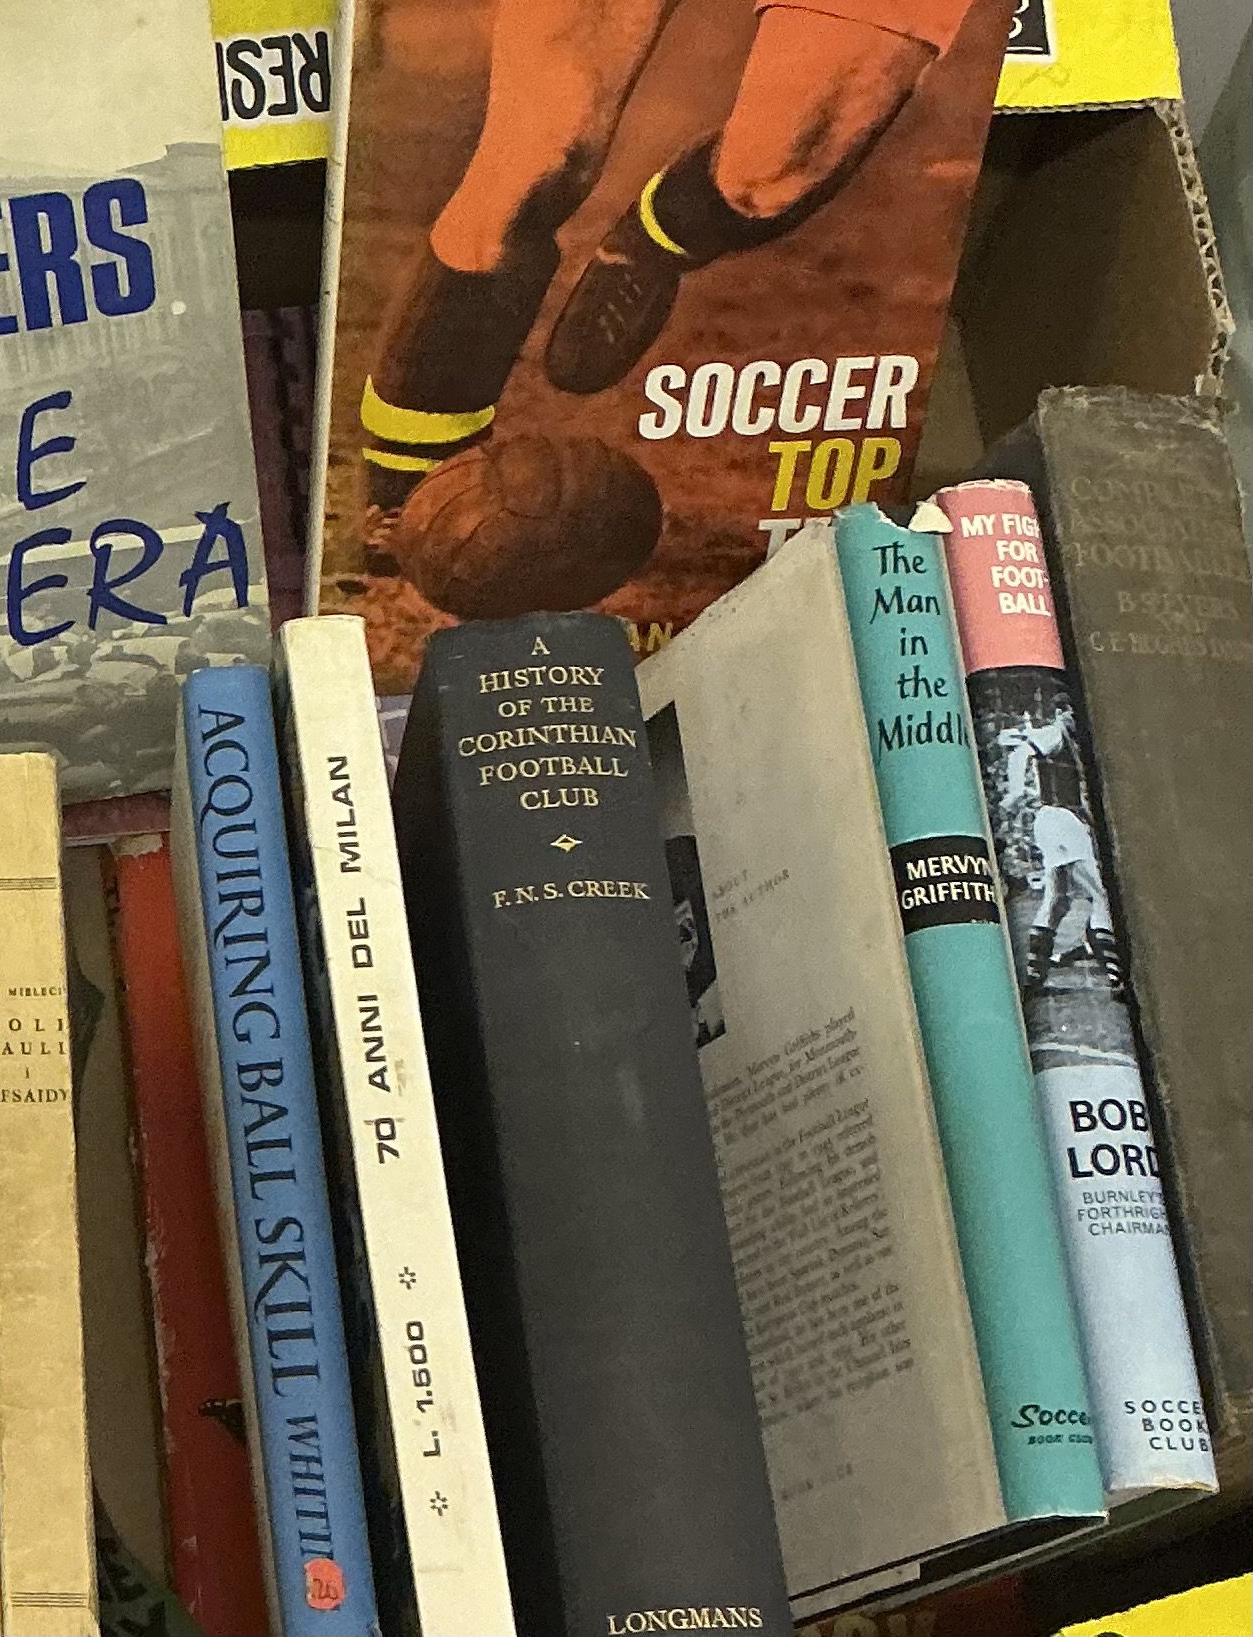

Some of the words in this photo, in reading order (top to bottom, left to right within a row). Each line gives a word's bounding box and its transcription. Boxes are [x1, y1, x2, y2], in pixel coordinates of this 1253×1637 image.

[215, 31, 332, 121] RES
[639, 354, 920, 440] SOCCER
[768, 437, 903, 511] TOP
[960, 514, 996, 538] MY
[872, 541, 927, 577] The
[995, 540, 1040, 564] FOR
[6, 501, 249, 647] ERA
[990, 565, 1050, 590] FOOT-
[870, 586, 942, 625] Man
[998, 592, 1052, 618] BALL
[531, 636, 551, 656] A
[899, 627, 928, 657] in
[478, 666, 605, 694] HISTORY
[897, 665, 950, 701] the
[498, 700, 532, 718] OF
[541, 696, 595, 714] THE
[458, 724, 636, 757] CORINTHIAN
[479, 756, 629, 786] FOOTBALL
[327, 755, 362, 873] MILAN
[520, 788, 599, 810] CLUB
[198, 704, 281, 1045] ACQUIRING
[567, 880, 650, 900] CREEK
[347, 897, 374, 969] DEL
[357, 995, 391, 1093] ANNI
[236, 1061, 299, 1201] BALL
[1068, 1098, 1149, 1132] BOB
[373, 1117, 401, 1164] 70
[254, 1216, 322, 1399] SKILL
[1142, 1417, 1210, 1432] BOOK
[424, 1429, 441, 1458] L.
[1149, 1436, 1209, 1452] CLUB
[607, 1606, 764, 1636] LONGMANS
